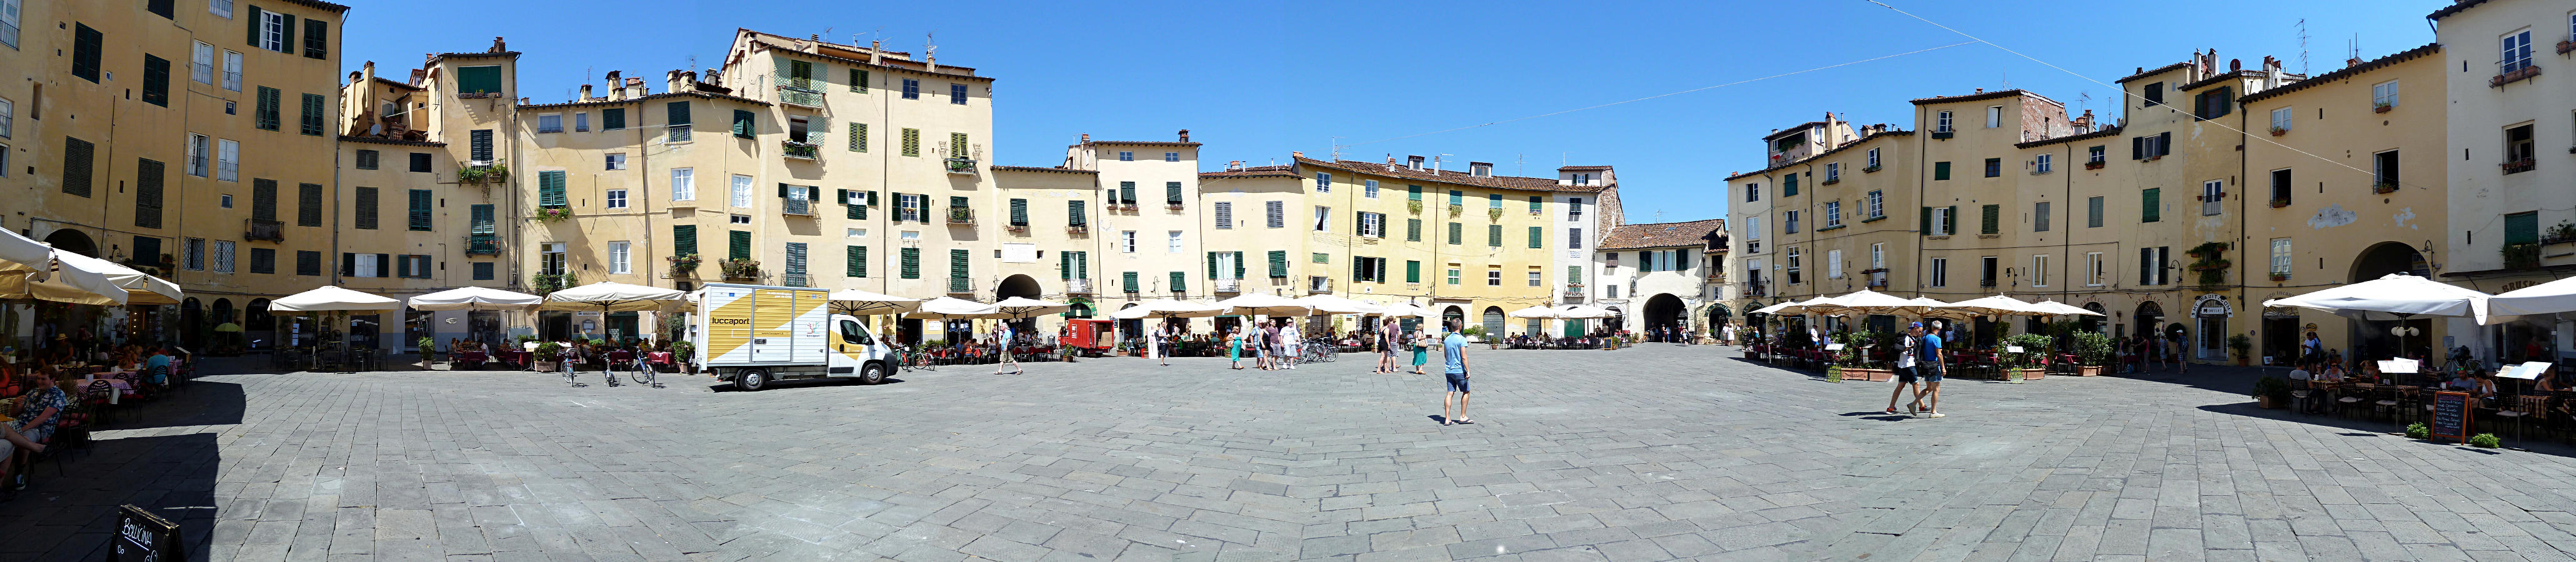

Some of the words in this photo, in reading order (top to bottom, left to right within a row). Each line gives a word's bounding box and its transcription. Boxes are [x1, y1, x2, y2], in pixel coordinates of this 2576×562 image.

[2502, 280, 2542, 293] BRUSK
[1068, 298, 1094, 308] GIRASOLE
[2192, 303, 2198, 311] MY
[712, 317, 749, 325] luccaport
